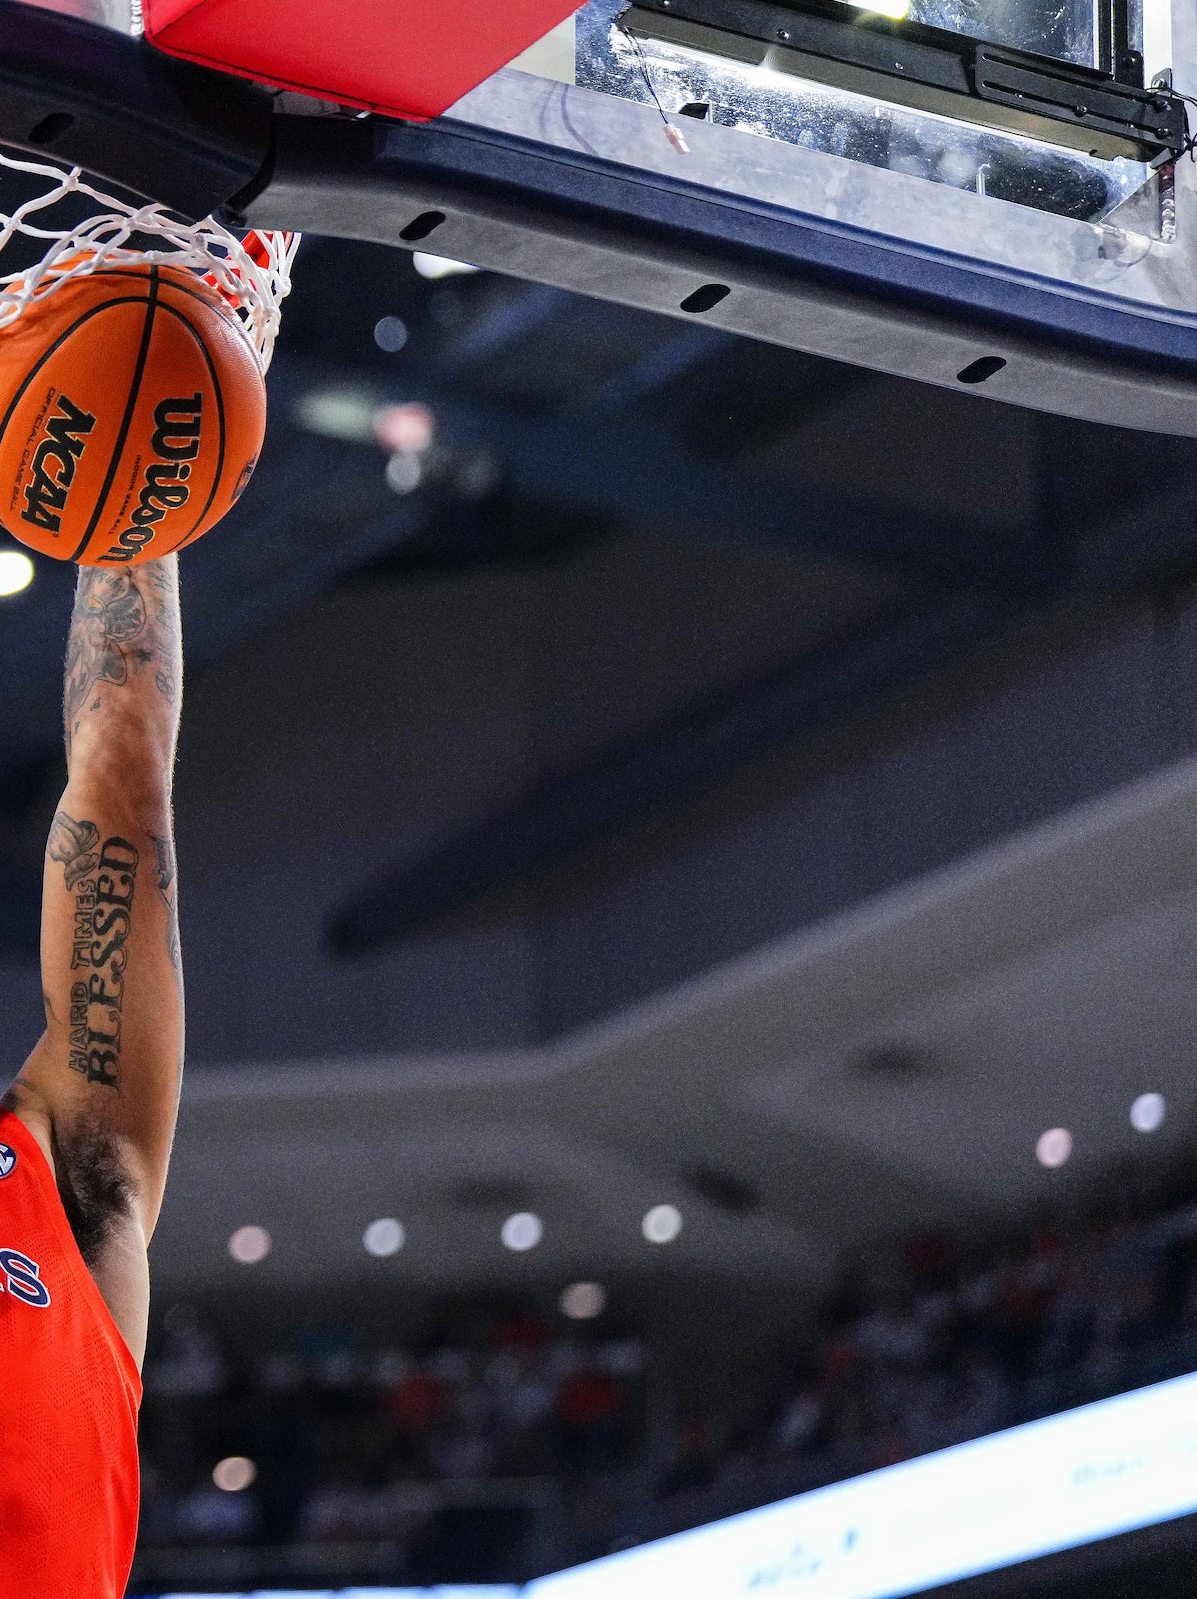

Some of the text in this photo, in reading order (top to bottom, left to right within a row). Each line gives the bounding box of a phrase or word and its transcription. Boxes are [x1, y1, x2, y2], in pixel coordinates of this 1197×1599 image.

[20, 392, 97, 533] NCAA
[97, 392, 203, 562] Wilson
[68, 878, 97, 1075] HARD TIMES
[86, 835, 140, 1091] BLESSED
